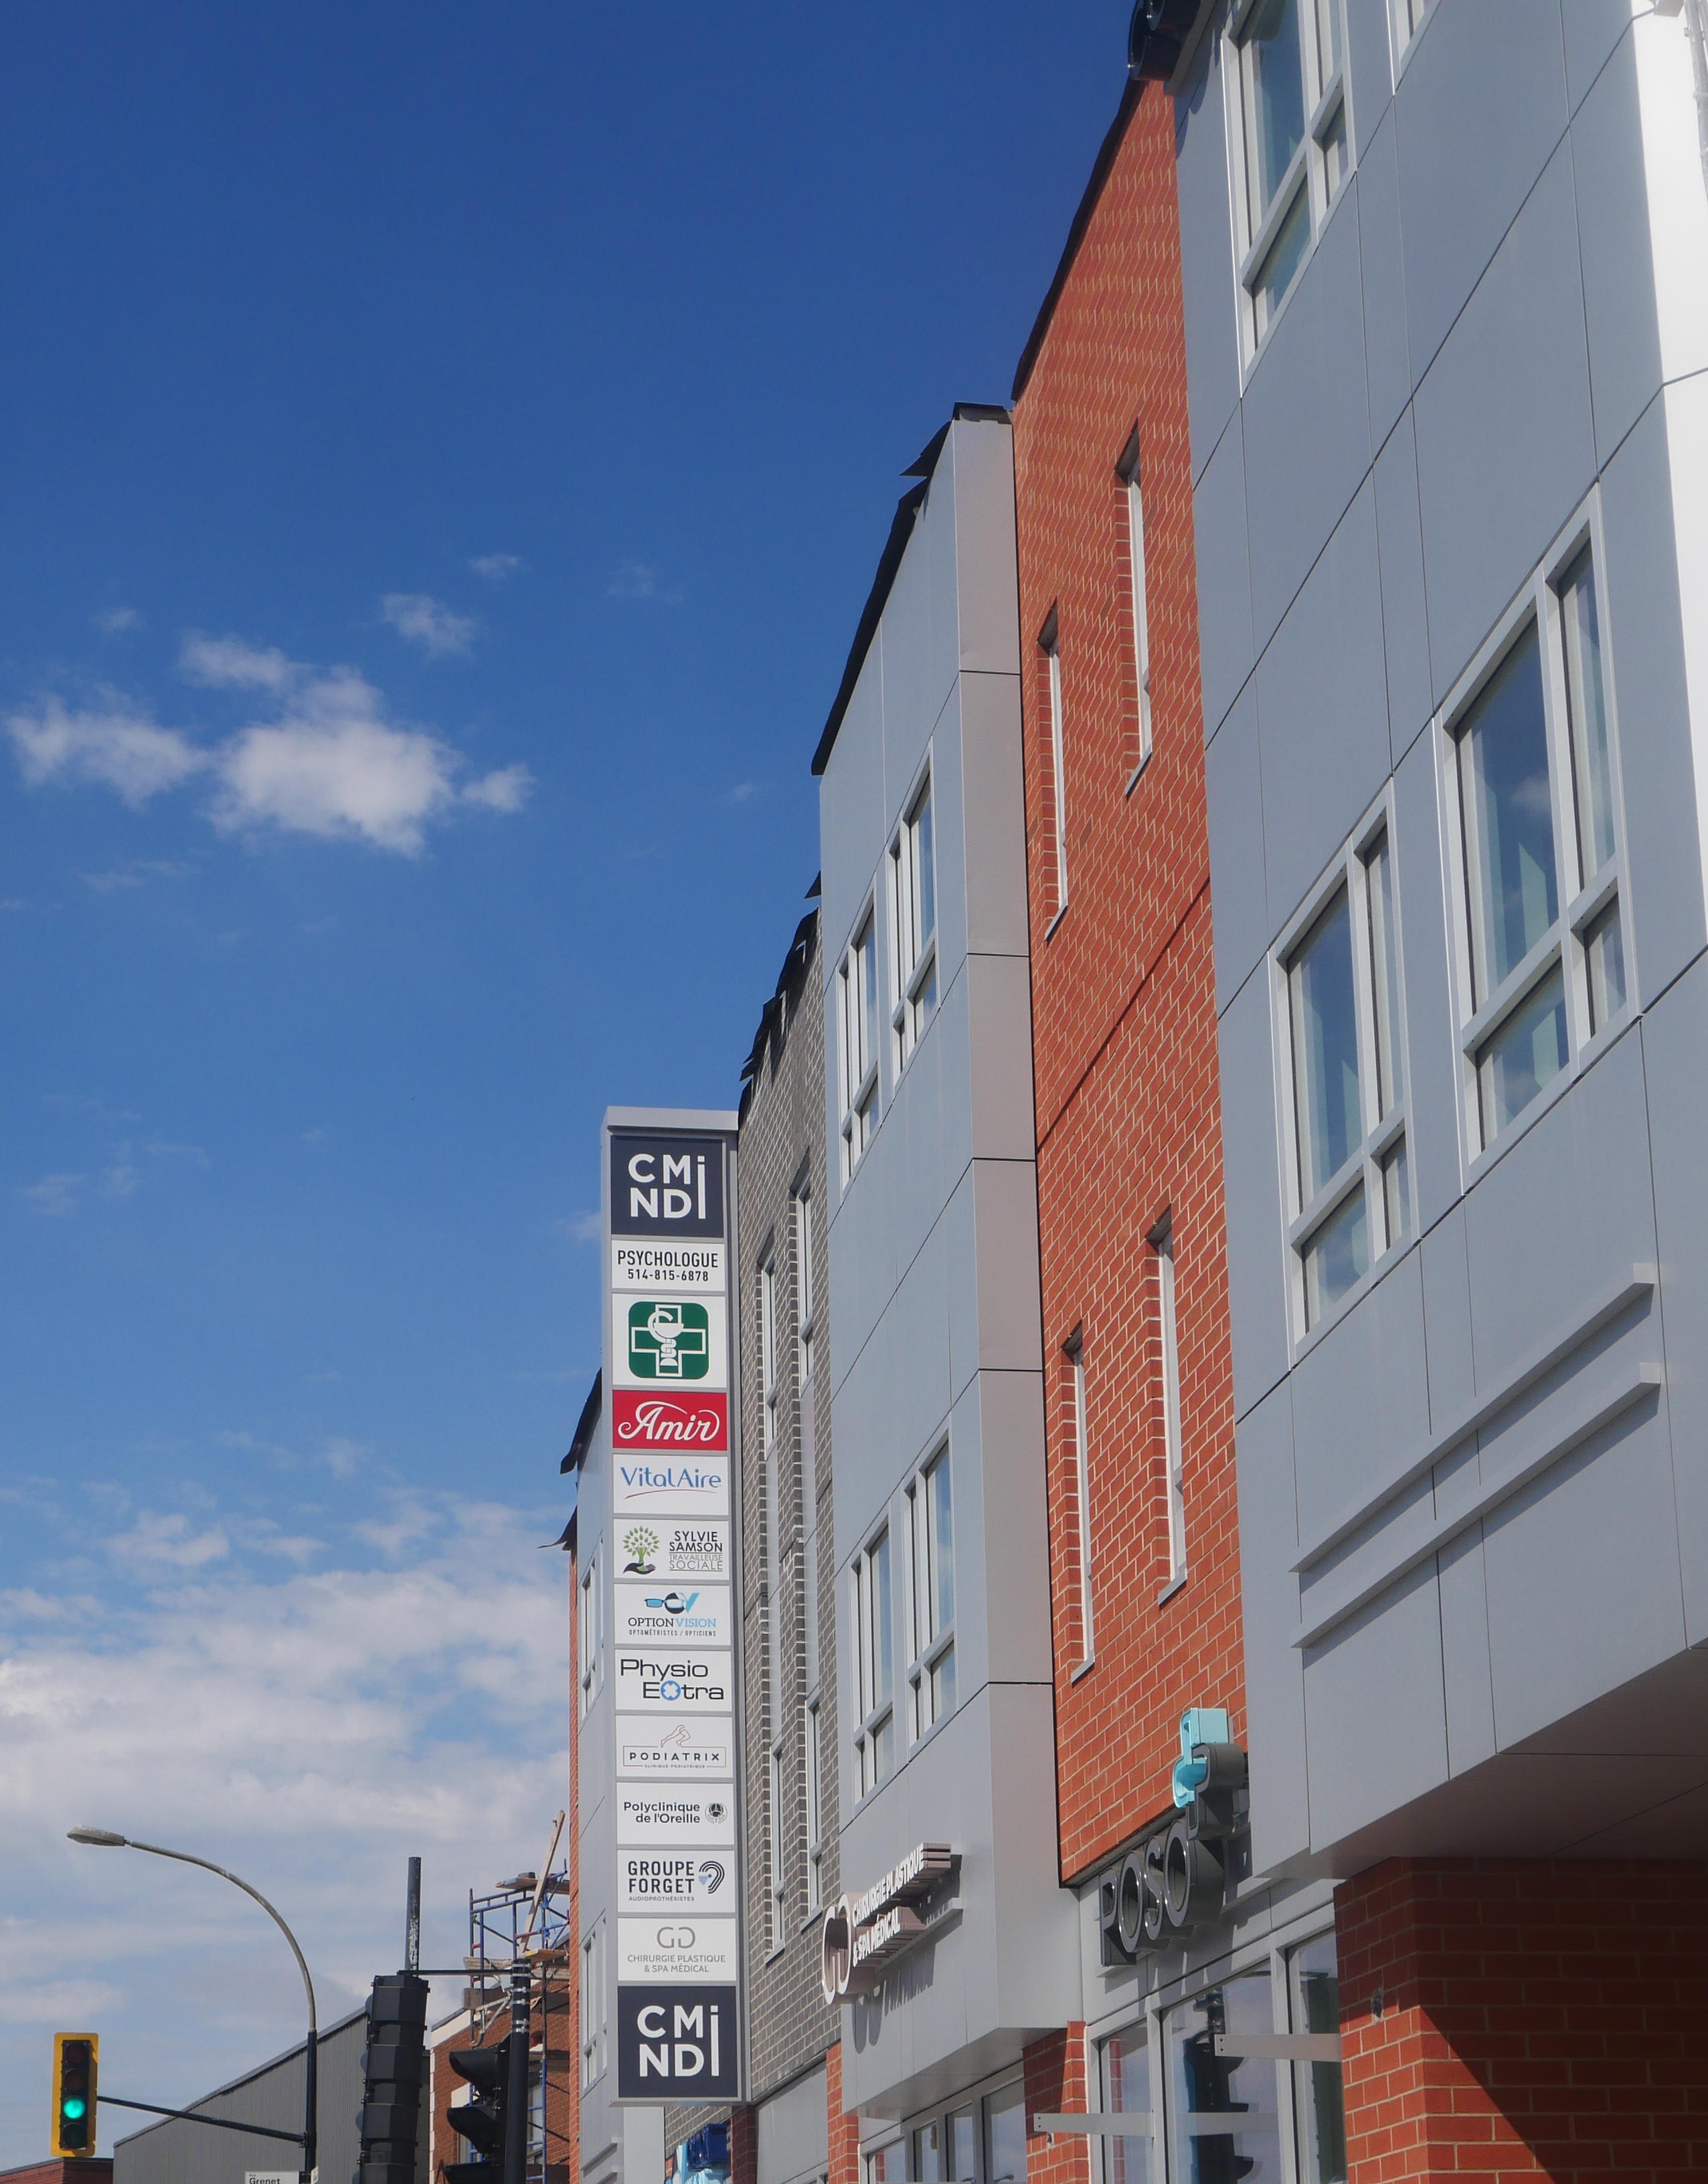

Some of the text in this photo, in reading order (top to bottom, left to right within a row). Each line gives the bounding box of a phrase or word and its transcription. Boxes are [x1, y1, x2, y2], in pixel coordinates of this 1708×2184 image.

[618, 1250, 718, 1268] PSYCHOLOGUE
[628, 1269, 709, 1281] 514-815-6878
[618, 1400, 719, 1441] Amir
[620, 1467, 721, 1487] VitalAire
[674, 1530, 717, 1542] SYLVIE
[669, 1542, 723, 1552] SAMSON
[669, 1560, 723, 1570] SOCIALE
[628, 1617, 717, 1627] OPTION VISION
[620, 1659, 708, 1681] Physio
[629, 1752, 719, 1761] PODIATRIX
[624, 1802, 700, 1813] Polyclinique
[636, 1813, 700, 1823] de l'Oreille
[628, 1861, 694, 1876] GROUPE
[628, 1878, 695, 1893] FORGET
[853, 1842, 924, 1928] CHIRURGIE PLASTIQUE
[627, 1954, 675, 1963] CHIRURGIE
[671, 1963, 709, 1973] MÉDICAL
